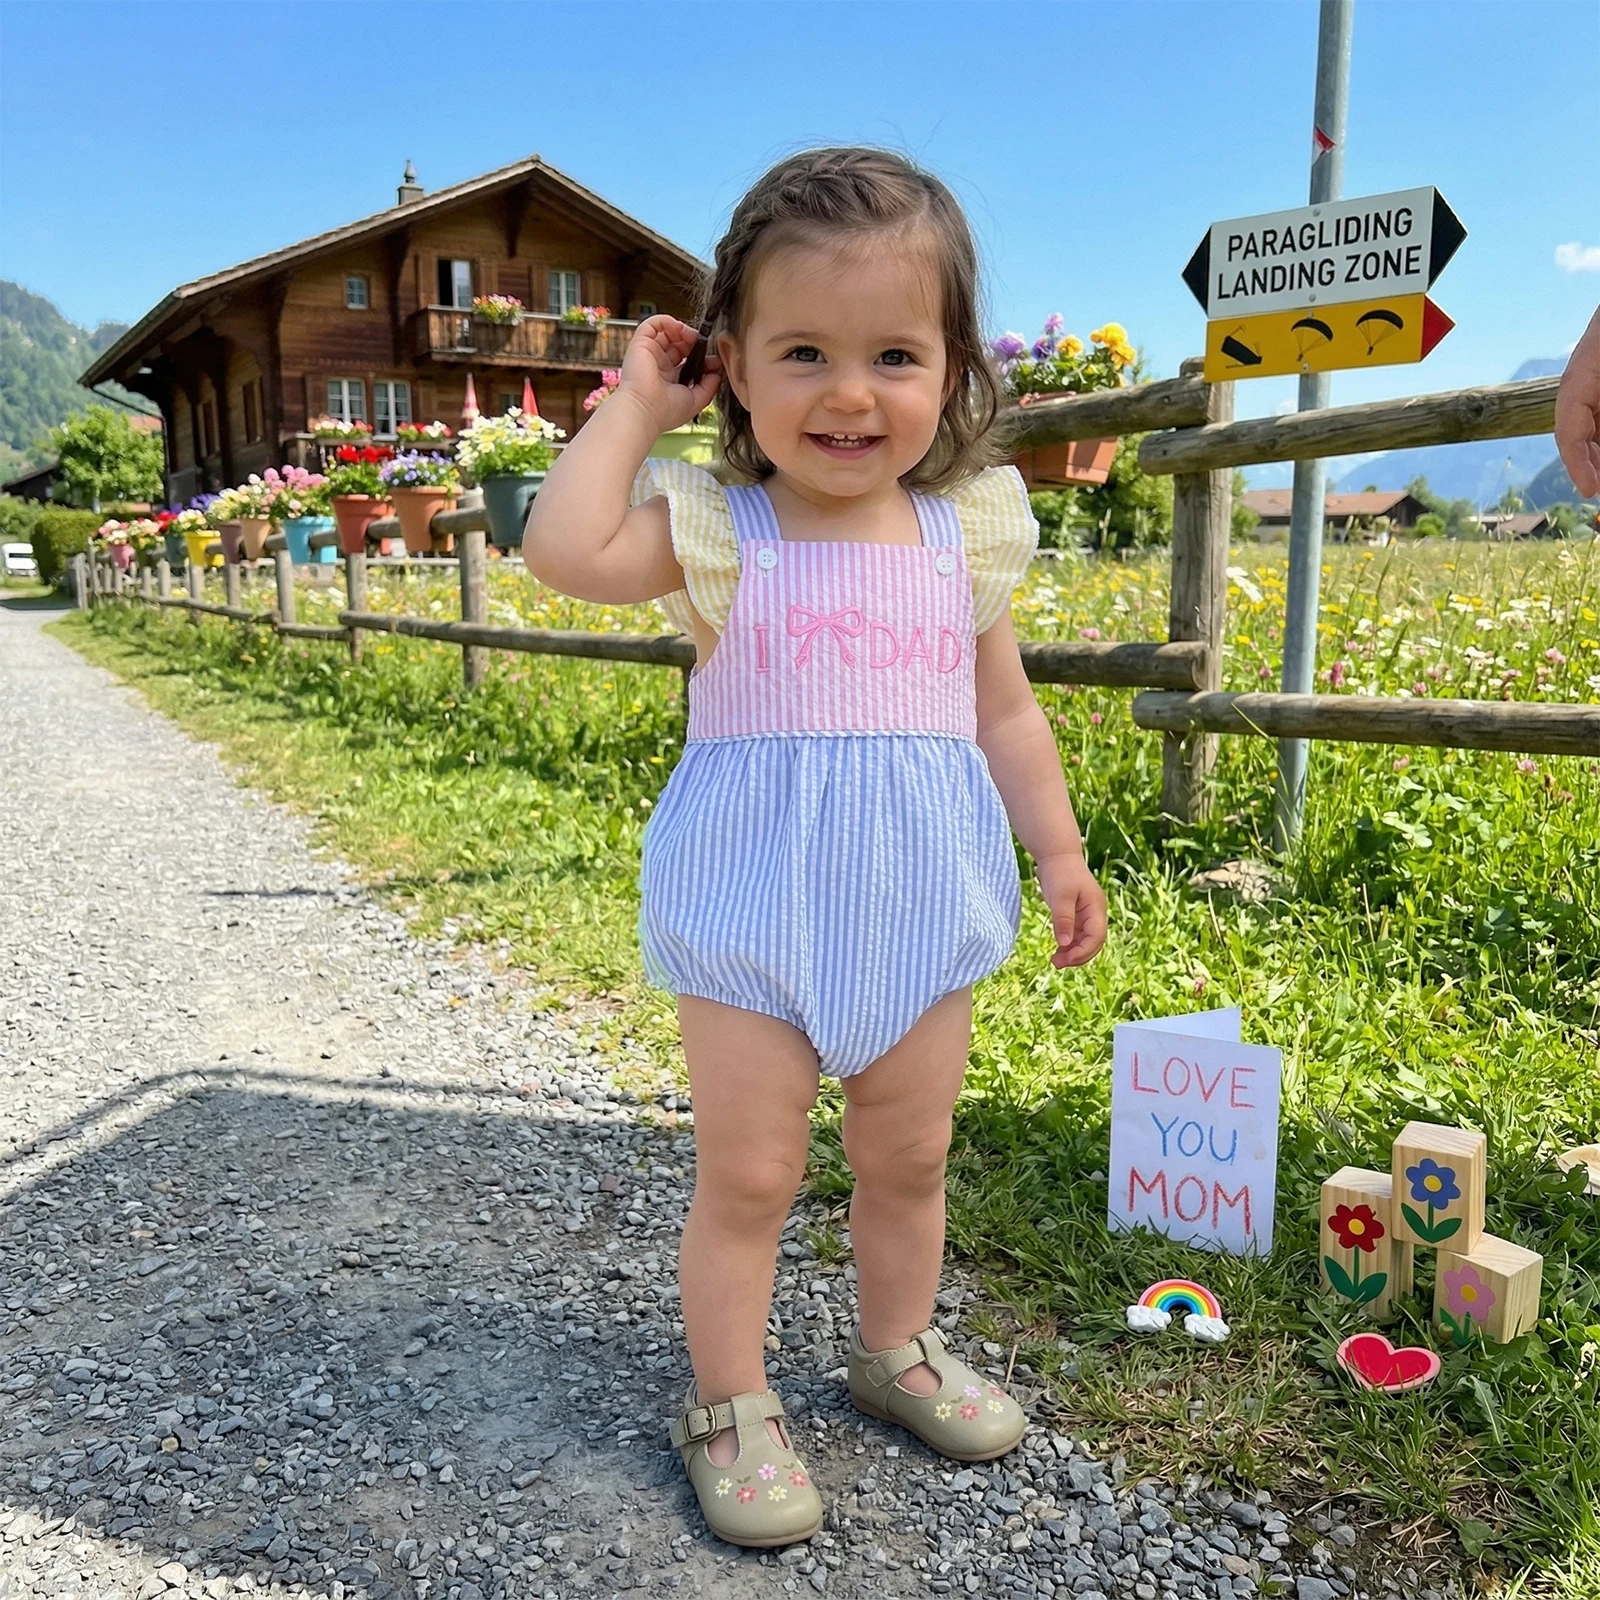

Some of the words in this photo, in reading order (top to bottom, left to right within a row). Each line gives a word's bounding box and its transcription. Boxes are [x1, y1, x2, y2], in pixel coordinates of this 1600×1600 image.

[1227, 207, 1413, 262] PARAGLIDING
[1217, 258, 1335, 300] LANDING
[1344, 244, 1422, 283] ZONE
[753, 623, 770, 673] I
[869, 620, 962, 673] DAD
[1131, 1051, 1257, 1108] LOVE
[1150, 1112, 1237, 1165] YOU
[1128, 1166, 1252, 1235] MOM
